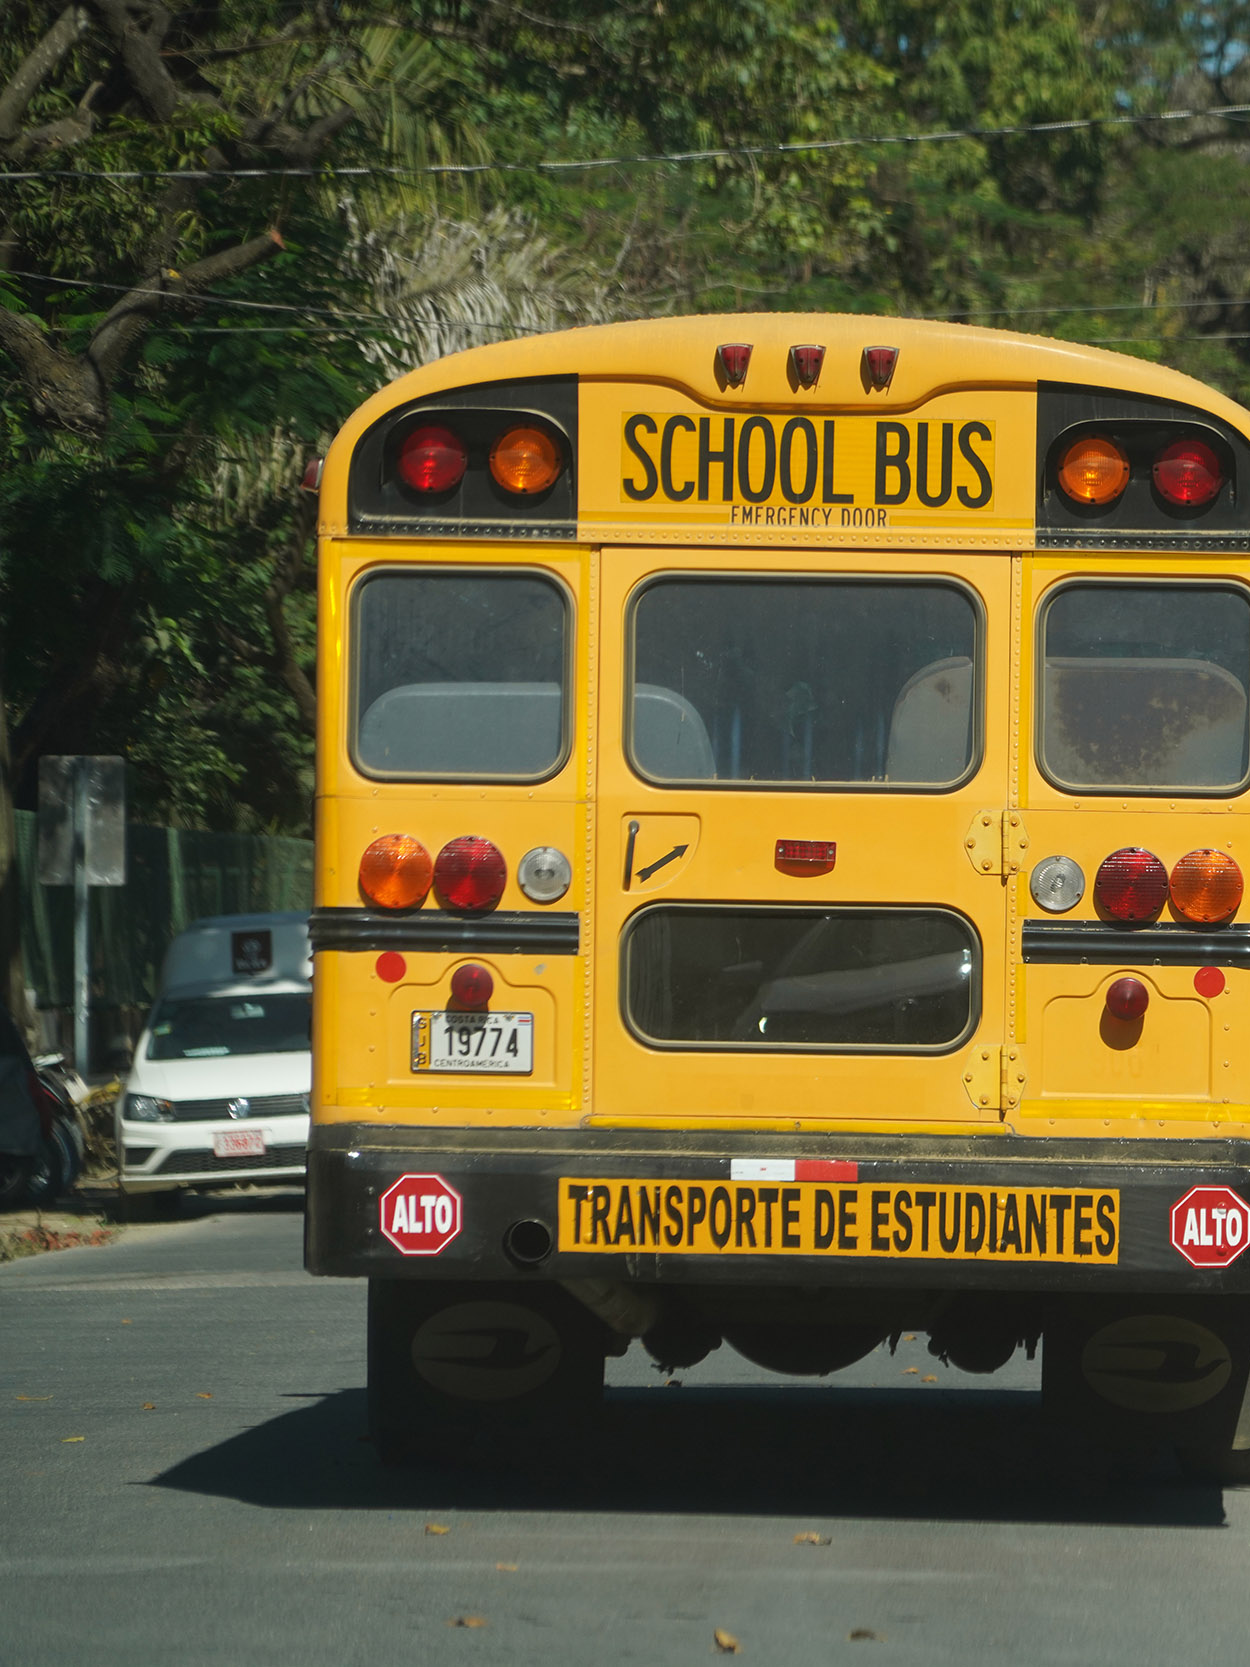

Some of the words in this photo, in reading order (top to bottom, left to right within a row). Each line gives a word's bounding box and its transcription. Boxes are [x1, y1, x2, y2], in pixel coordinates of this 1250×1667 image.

[622, 413, 854, 504] SCHOOL
[874, 420, 993, 509] BUS
[731, 505, 832, 527] EMERGENCY
[841, 508, 888, 528] DOOR
[446, 1014, 476, 1024] COSTA
[477, 1015, 499, 1025] RICA
[444, 1026, 519, 1058] 19774
[433, 1058, 510, 1069] CENTROAMERICA
[391, 1193, 453, 1235] ALTO
[568, 1184, 800, 1249] TRANSPORTE
[813, 1188, 858, 1250] DE
[870, 1189, 1116, 1258] ESTUDIANTES
[1182, 1206, 1244, 1248] ALTO
